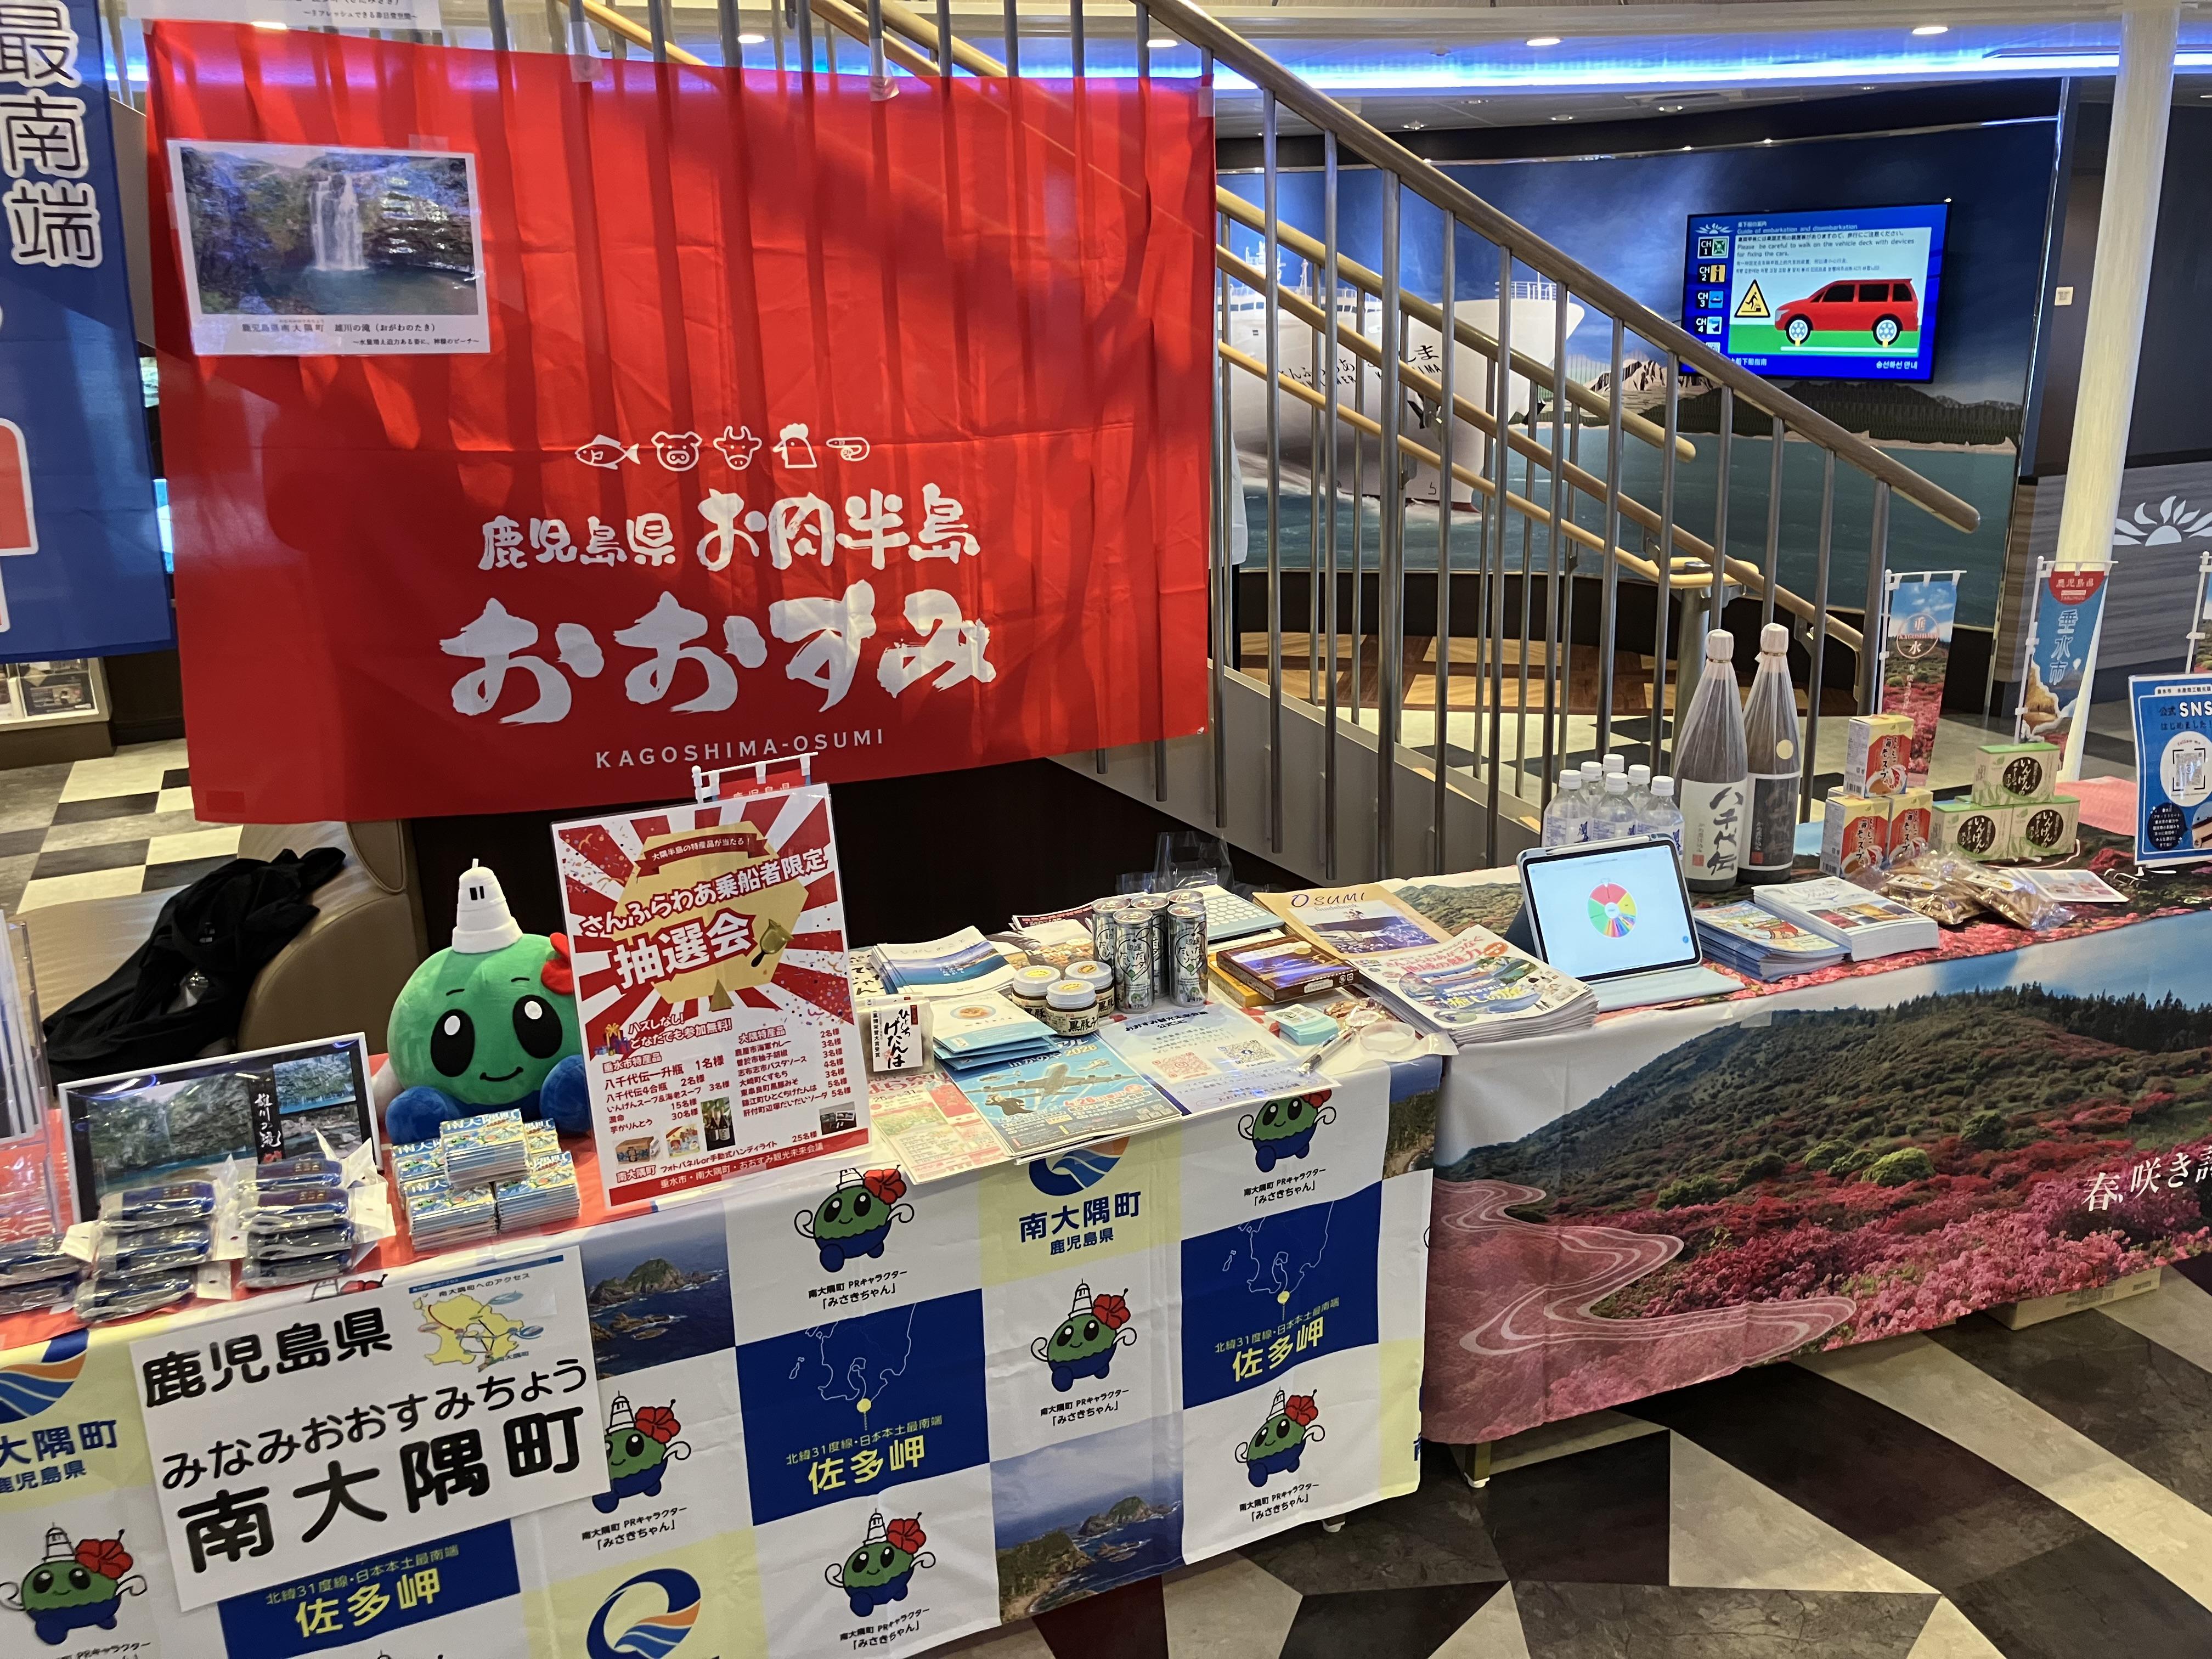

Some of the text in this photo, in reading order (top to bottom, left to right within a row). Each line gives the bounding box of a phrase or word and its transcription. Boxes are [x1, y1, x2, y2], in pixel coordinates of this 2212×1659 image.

[477, 483, 981, 571] 鹿児島県 お肉半島
[2056, 578, 2094, 588] 鹿児島県
[439, 578, 997, 726] おおすみ
[1909, 640, 1922, 655] 水
[2049, 608, 2079, 686] 垂水市
[2179, 701, 2212, 718] SNS
[595, 729, 885, 769] KAGOSHIMA-OSUMI
[1707, 786, 1744, 876] 八千代伝
[651, 837, 750, 861] 大隅半島の特産品が当たる！
[1291, 892, 1365, 908] OSUMI
[1314, 903, 1357, 912] Guidebook
[613, 911, 752, 990] 抽選会
[739, 1025, 786, 1045] 大隅特産品
[820, 1028, 840, 1038] 2名様
[898, 1009, 911, 1037] ひとくち
[821, 1037, 842, 1048] 3名様
[823, 1048, 843, 1058] 3名様
[884, 1016, 909, 1069] げたんは
[1065, 1044, 1098, 1057] 2026
[602, 1052, 662, 1074] 垂水市特産品
[605, 1055, 725, 1091] 八千代伝一升瓶 1名様
[824, 1058, 844, 1068] 4名様
[825, 1068, 845, 1078] 3名様
[606, 1074, 705, 1103] 八千代伝4合瓶 2名様
[709, 1080, 730, 1092] 3名様
[828, 1077, 848, 1088] 5名様
[832, 1087, 851, 1098] 5名様
[672, 1098, 697, 1110] 15名様
[610, 1108, 698, 1135] 芋かりんとう 30名様
[617, 1165, 656, 1183] 南大隅町
[792, 1130, 817, 1143] 25名様
[1244, 1168, 1326, 1197] 南大隅町 PRキャラクター
[1254, 1180, 1316, 1206] 「みさきちゃん」
[1019, 1191, 1141, 1243] 南大隅町
[1050, 1227, 1114, 1255] 鹿児島県
[439, 1273, 531, 1297] 南大隅町へのアクセス
[808, 1271, 907, 1299] 南大隅町 PRキャラクター
[822, 1283, 895, 1310] 「みさきちゃん」
[1214, 1296, 1340, 1354] 北緯31度線・日本本土最南端
[142, 1307, 393, 1408] 鹿児島県
[1232, 1316, 1324, 1383] 佐多岬
[1040, 1389, 1129, 1417] 南大隅町 PRキャラクター
[1052, 1400, 1118, 1426] 「みさきちゃん」
[162, 1358, 588, 1489] みなみおおすみちょう
[0, 1419, 117, 1468] 大隅町
[786, 1414, 943, 1465] 北緯31度線・日本本土最南端
[808, 1435, 925, 1495] 佐多岬
[177, 1406, 584, 1575] 南大隅町
[582, 1507, 687, 1541] 南大隅町 PRキャラクター
[597, 1519, 675, 1550] 「みさきちゃん」
[266, 1544, 459, 1605] 北緯31度線・日本本土最南端
[295, 1567, 440, 1638] 佐多岬
